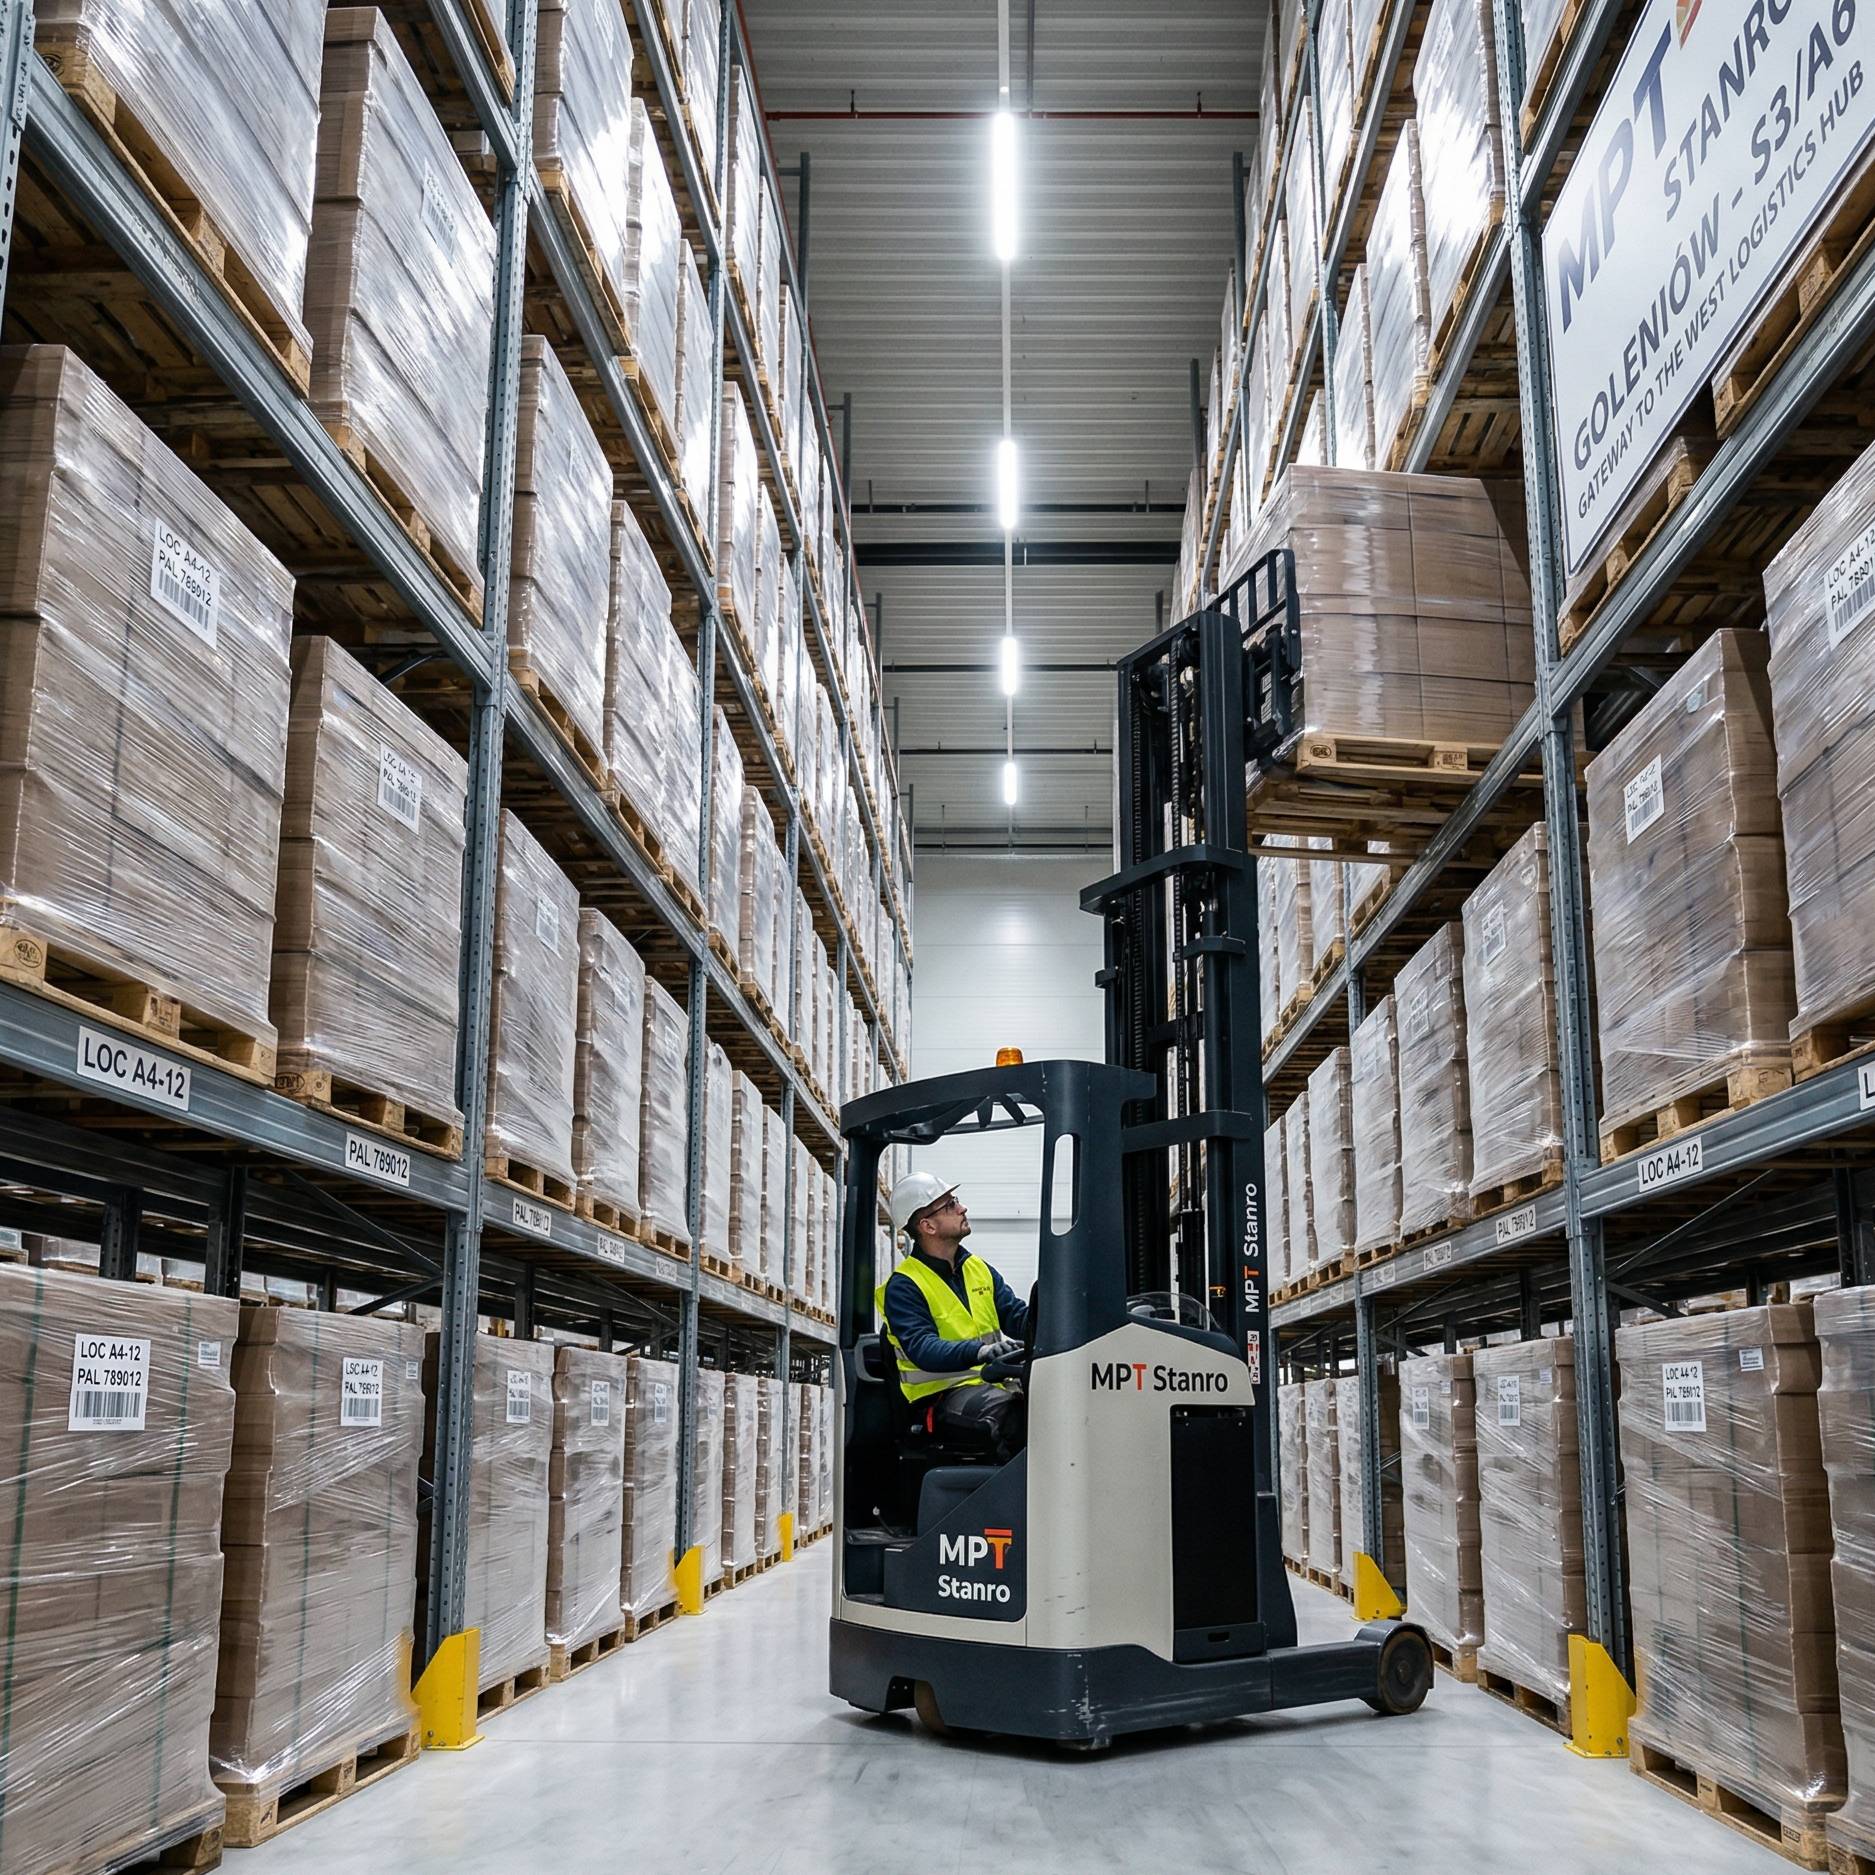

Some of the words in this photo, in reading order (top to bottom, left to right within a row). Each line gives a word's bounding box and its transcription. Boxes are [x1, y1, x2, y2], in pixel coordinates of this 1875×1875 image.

[1558, 19, 1672, 335] MPT
[1577, 414, 1635, 519] GATEWAY
[1636, 387, 1655, 428] TO
[1655, 338, 1684, 395] THE
[1684, 271, 1725, 352] WEST
[1729, 129, 1817, 285] LOGISTICS
[1819, 60, 1864, 145] HUB
[1574, 192, 1720, 471] GOLENIÓW
[159, 525, 181, 556] LOC
[158, 549, 178, 579] PAL
[1828, 560, 1847, 589] LOC
[84, 1037, 128, 1078] LOC
[131, 1056, 186, 1099] A4-12
[350, 1140, 371, 1167] PAL
[1641, 1157, 1664, 1184] LOC
[1667, 1143, 1699, 1176] A4-12
[1244, 1183, 1259, 1258] Stanro
[1244, 1265, 1260, 1313] MPT
[81, 1341, 106, 1359] LOC
[108, 1343, 141, 1361] A4-12
[77, 1368, 100, 1385] PAL
[103, 1370, 142, 1386] 789012
[1091, 1362, 1147, 1391] MPT
[1153, 1365, 1229, 1392] Stanro
[939, 1528, 1013, 1570] MPT
[938, 1574, 1012, 1603] Stanro
